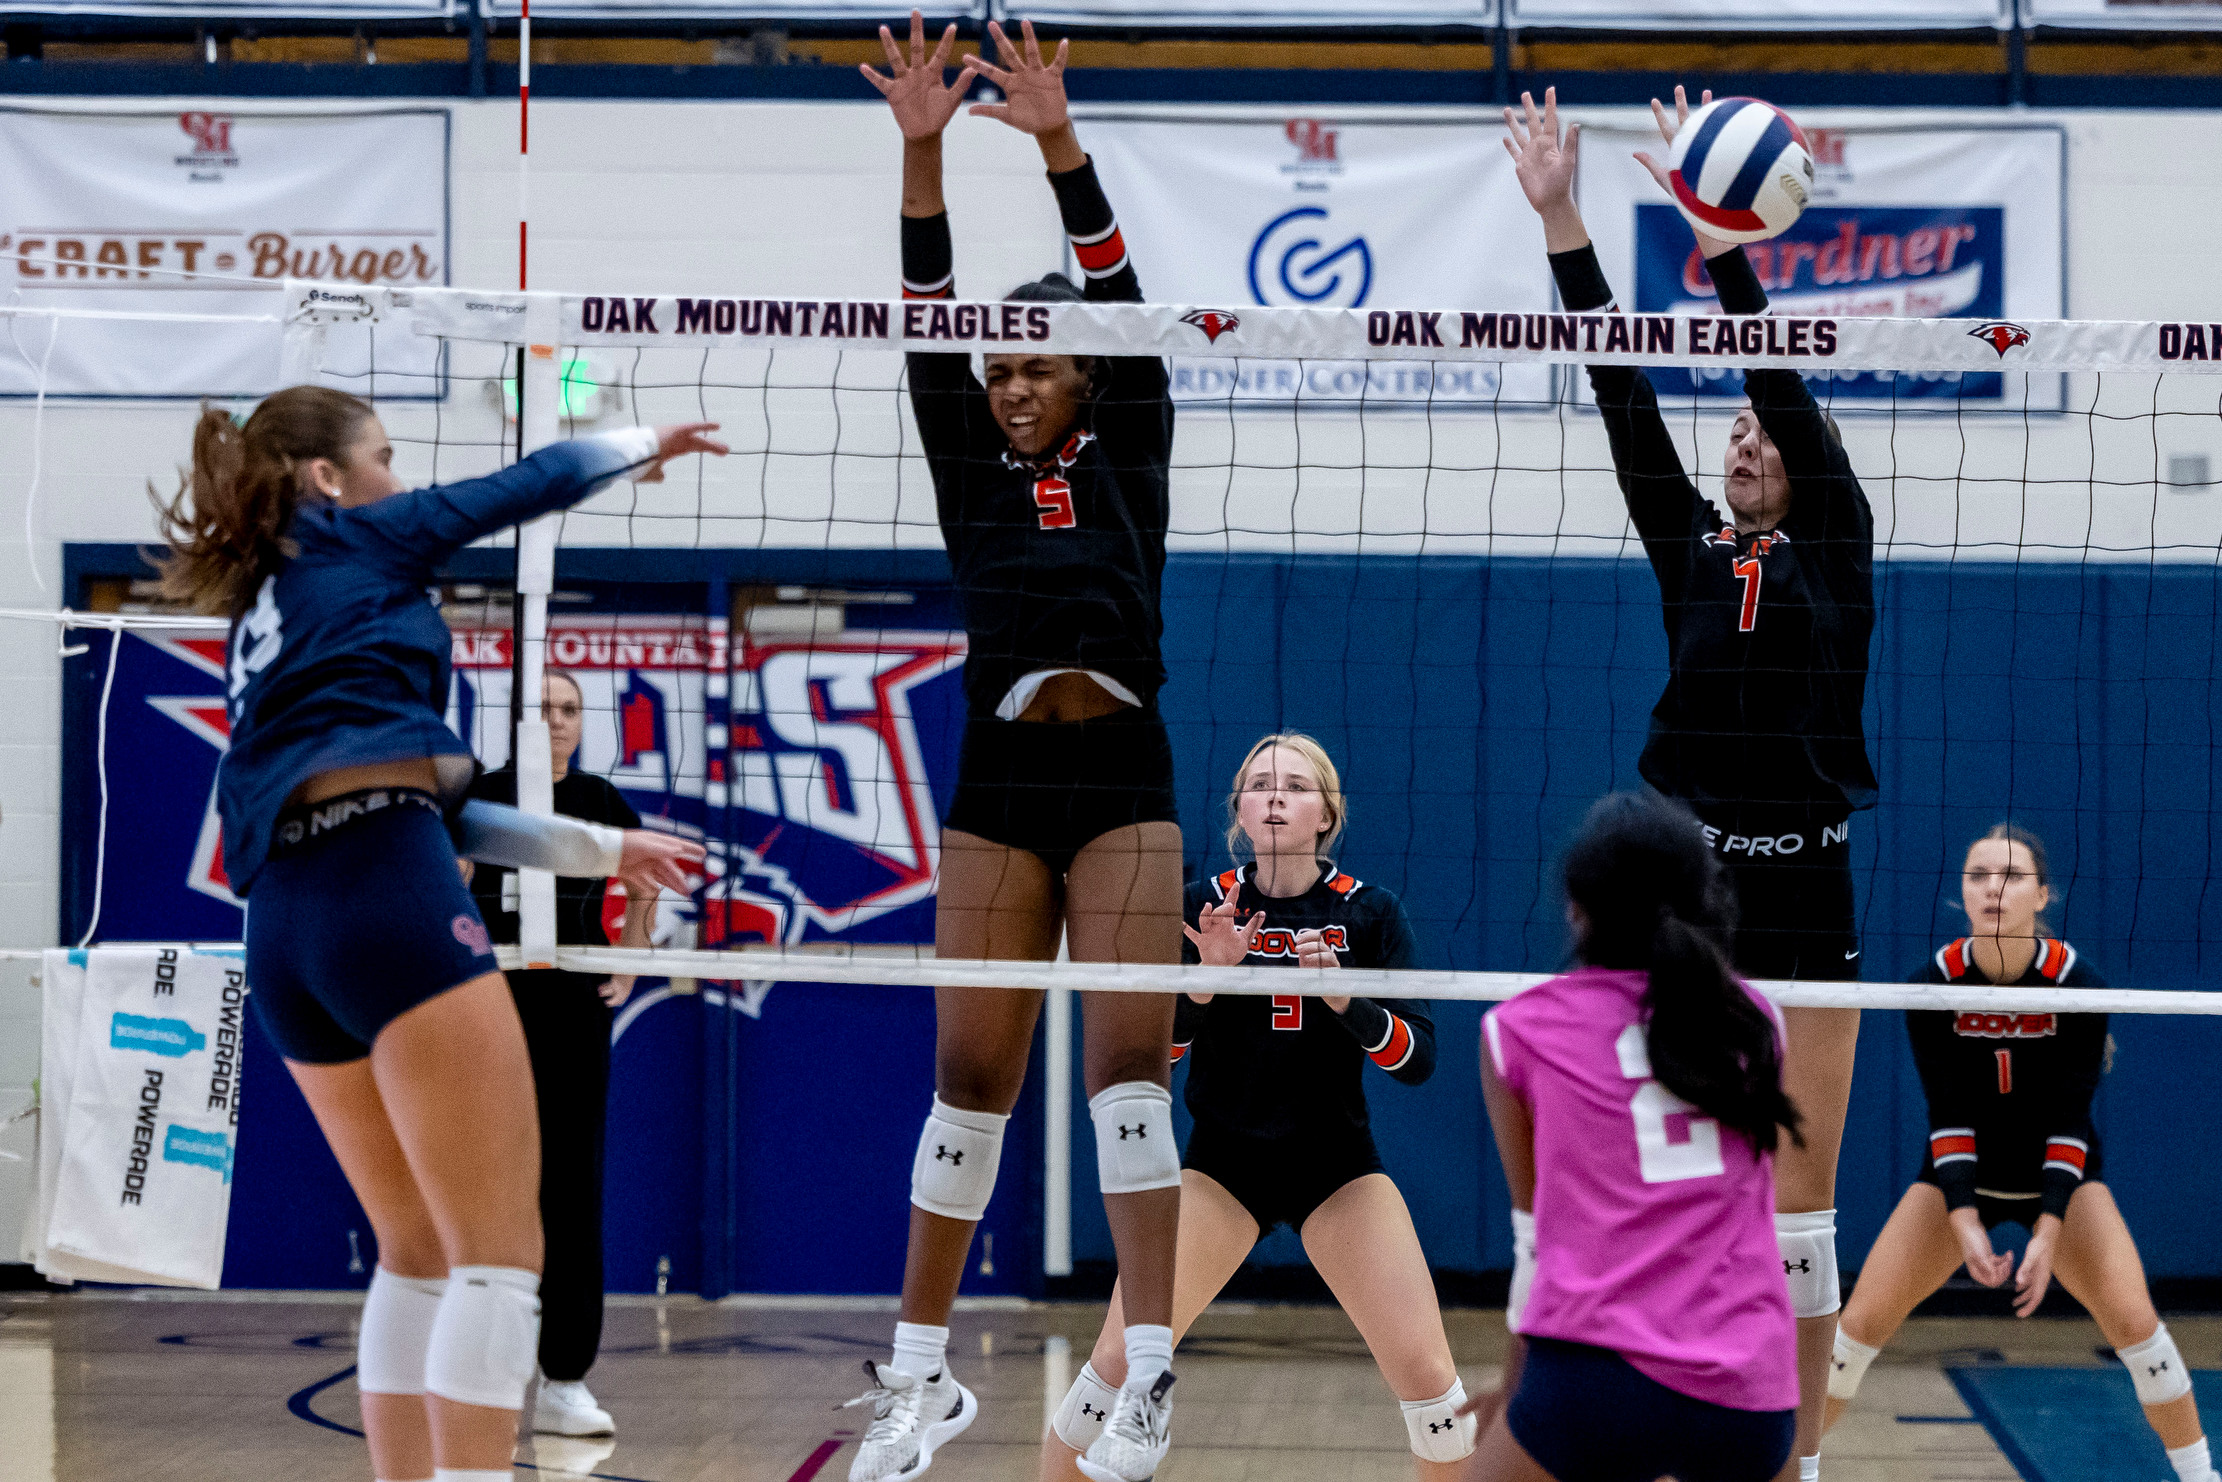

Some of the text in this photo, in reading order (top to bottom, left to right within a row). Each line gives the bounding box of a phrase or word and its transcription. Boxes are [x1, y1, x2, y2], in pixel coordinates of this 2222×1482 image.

[17, 240, 205, 278] CRAFT
[247, 232, 437, 284] Burger
[582, 297, 1050, 341] OAK MOUNTAIN EAGLES
[1367, 311, 1838, 357] OAK MOUNTAIN EAGLES
[1172, 367, 1297, 396] RDNER
[1032, 473, 1077, 530] 5
[451, 631, 745, 669] AK OUNTAI
[1722, 833, 1804, 857] PRO
[207, 969, 243, 1113] POWERADE
[1994, 1047, 2012, 1094] 1
[1615, 1024, 1725, 1183] 2
[121, 1068, 164, 1207] POWERADE
